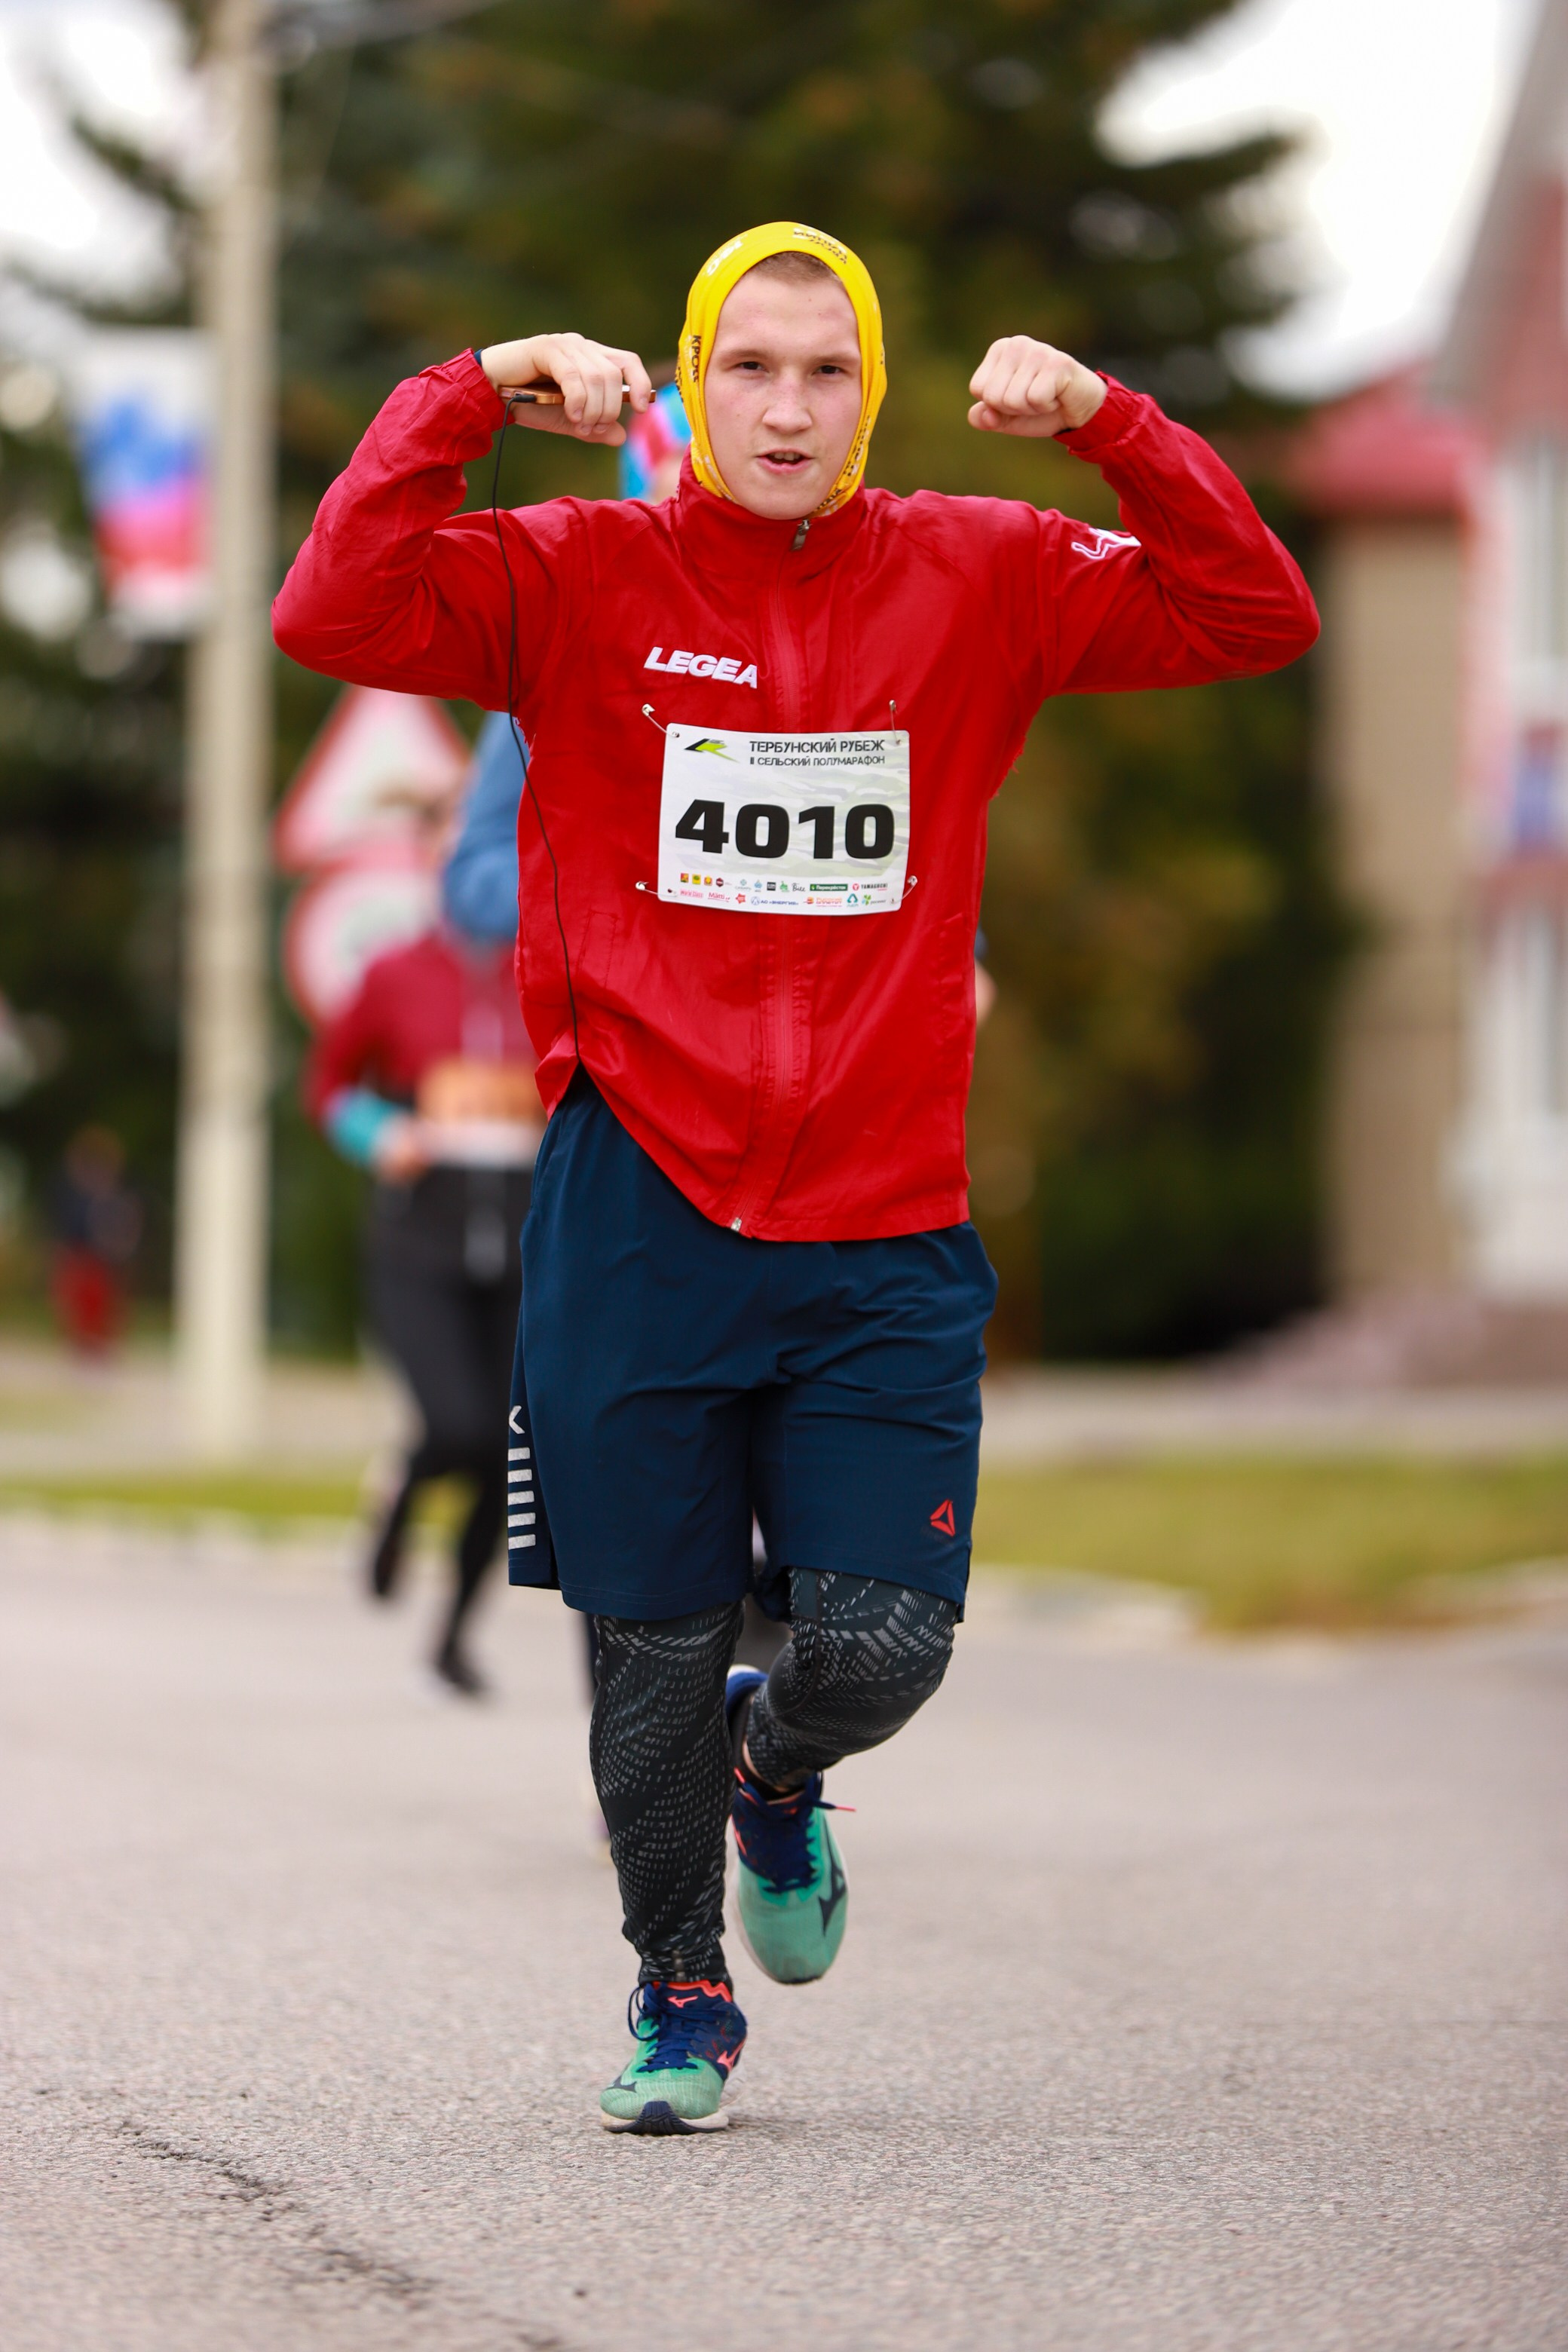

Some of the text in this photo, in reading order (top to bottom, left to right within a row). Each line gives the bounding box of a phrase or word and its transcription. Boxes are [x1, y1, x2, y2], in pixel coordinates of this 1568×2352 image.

[643, 646, 758, 689] LEGEA
[749, 738, 885, 753] ТЕРБУНСКИЙ РУБЕЖ
[758, 755, 811, 766] СЕЛЬСКИЙ
[813, 755, 885, 766] ПОЛУМАРАФОН
[675, 799, 896, 859] 4010
